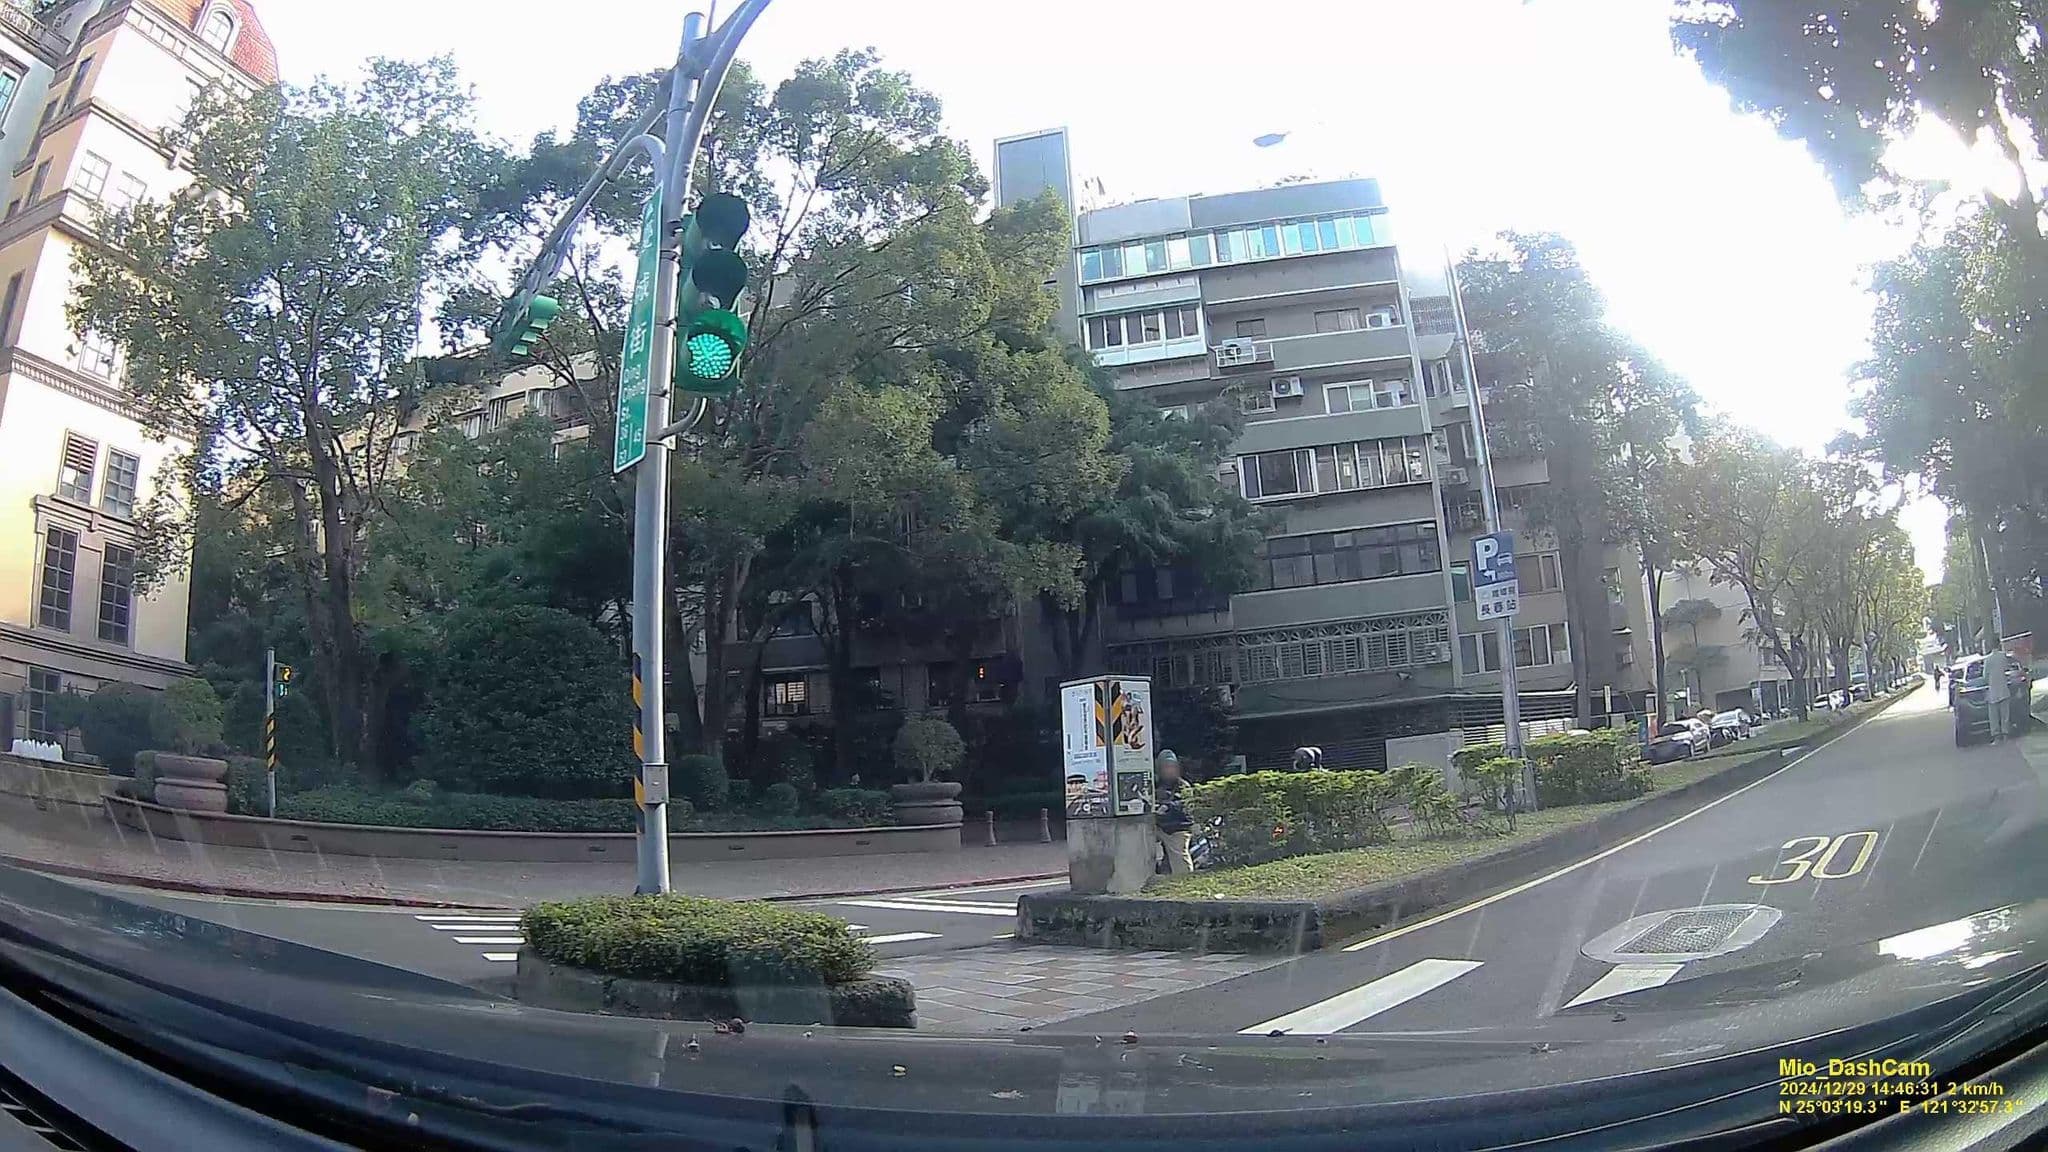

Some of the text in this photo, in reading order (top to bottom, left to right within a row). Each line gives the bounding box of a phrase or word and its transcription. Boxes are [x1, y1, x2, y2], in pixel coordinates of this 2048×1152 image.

[1475, 538, 1498, 571] P
[1481, 600, 1517, 616] 長春站
[1747, 830, 1879, 884] 30
